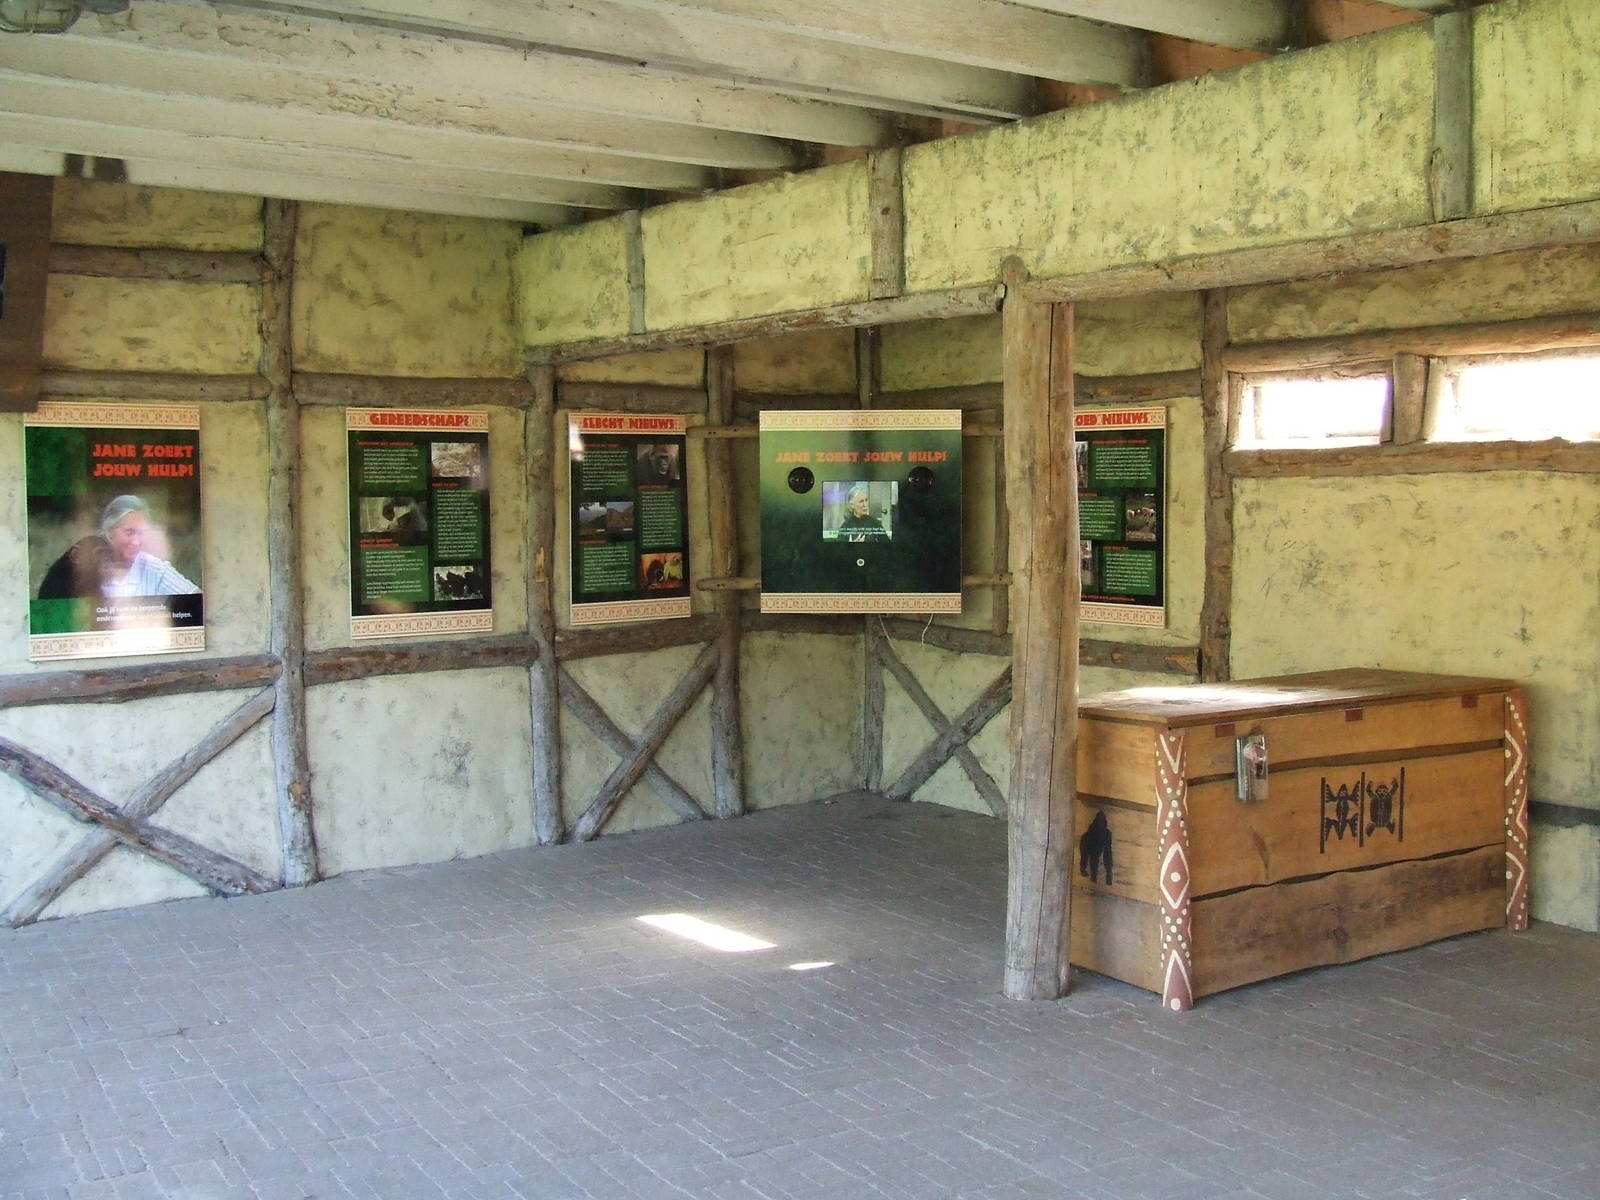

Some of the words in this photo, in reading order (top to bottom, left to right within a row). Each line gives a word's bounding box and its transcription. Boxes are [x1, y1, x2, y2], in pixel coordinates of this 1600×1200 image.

[370, 413, 469, 426] GEREEDSCHAP?
[583, 417, 624, 429] SLECHT
[629, 418, 675, 429] NIEUWS
[1075, 414, 1097, 426] OED
[1102, 412, 1148, 425] NIEUWS
[93, 444, 136, 457] JANE
[142, 444, 193, 458] ZOEKT
[776, 452, 810, 462] JANE
[816, 452, 859, 462] ZOEKT
[863, 452, 903, 462] JOUW
[908, 451, 947, 462] HULP!
[94, 463, 142, 477] JOUW
[147, 463, 193, 477] HULP!
